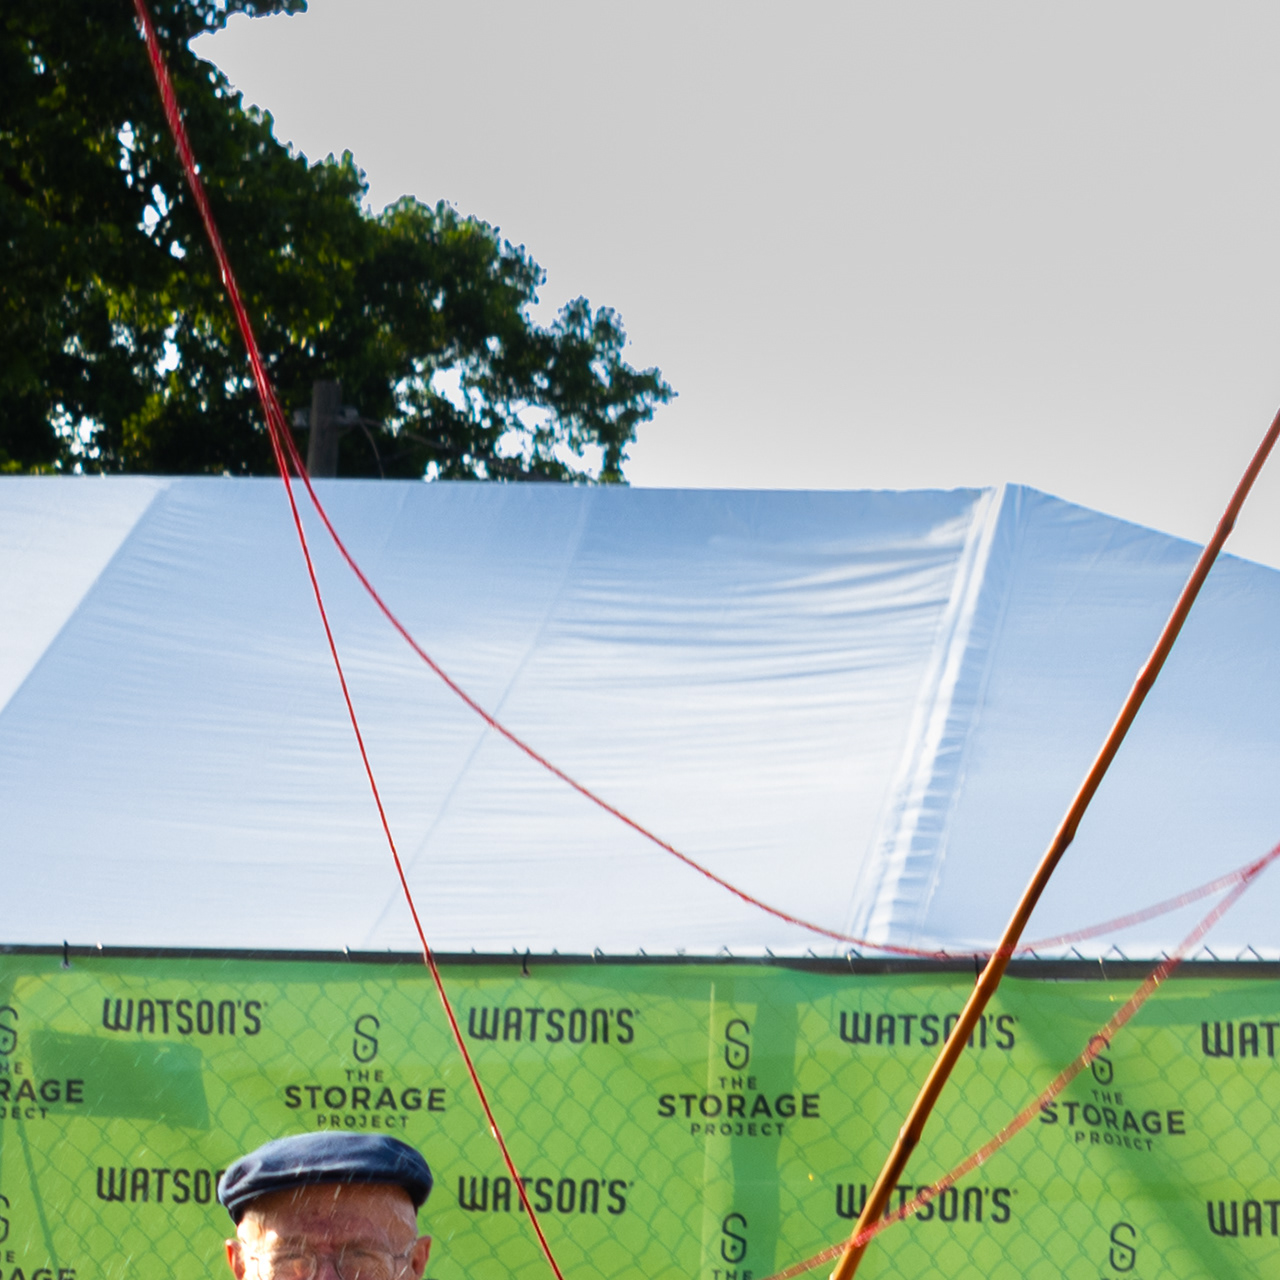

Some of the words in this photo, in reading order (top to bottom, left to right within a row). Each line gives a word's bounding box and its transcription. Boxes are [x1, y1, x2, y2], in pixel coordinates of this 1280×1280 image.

[102, 999, 262, 1036] WATSON'S
[469, 1007, 634, 1044] WATSON'S
[346, 1069, 383, 1082] THE
[720, 1077, 757, 1090] THE
[285, 1086, 446, 1111] STORAGE
[658, 1094, 820, 1119] STORAGE
[1092, 1089, 1123, 1105] THE
[317, 1116, 409, 1128] PROJECT
[691, 1123, 785, 1137] PROJECT
[1040, 1102, 1185, 1135] STORAGE
[1075, 1131, 1153, 1151] PROJECT
[459, 1176, 627, 1215] WATSON'S
[836, 1184, 1010, 1223] WTSON'S
